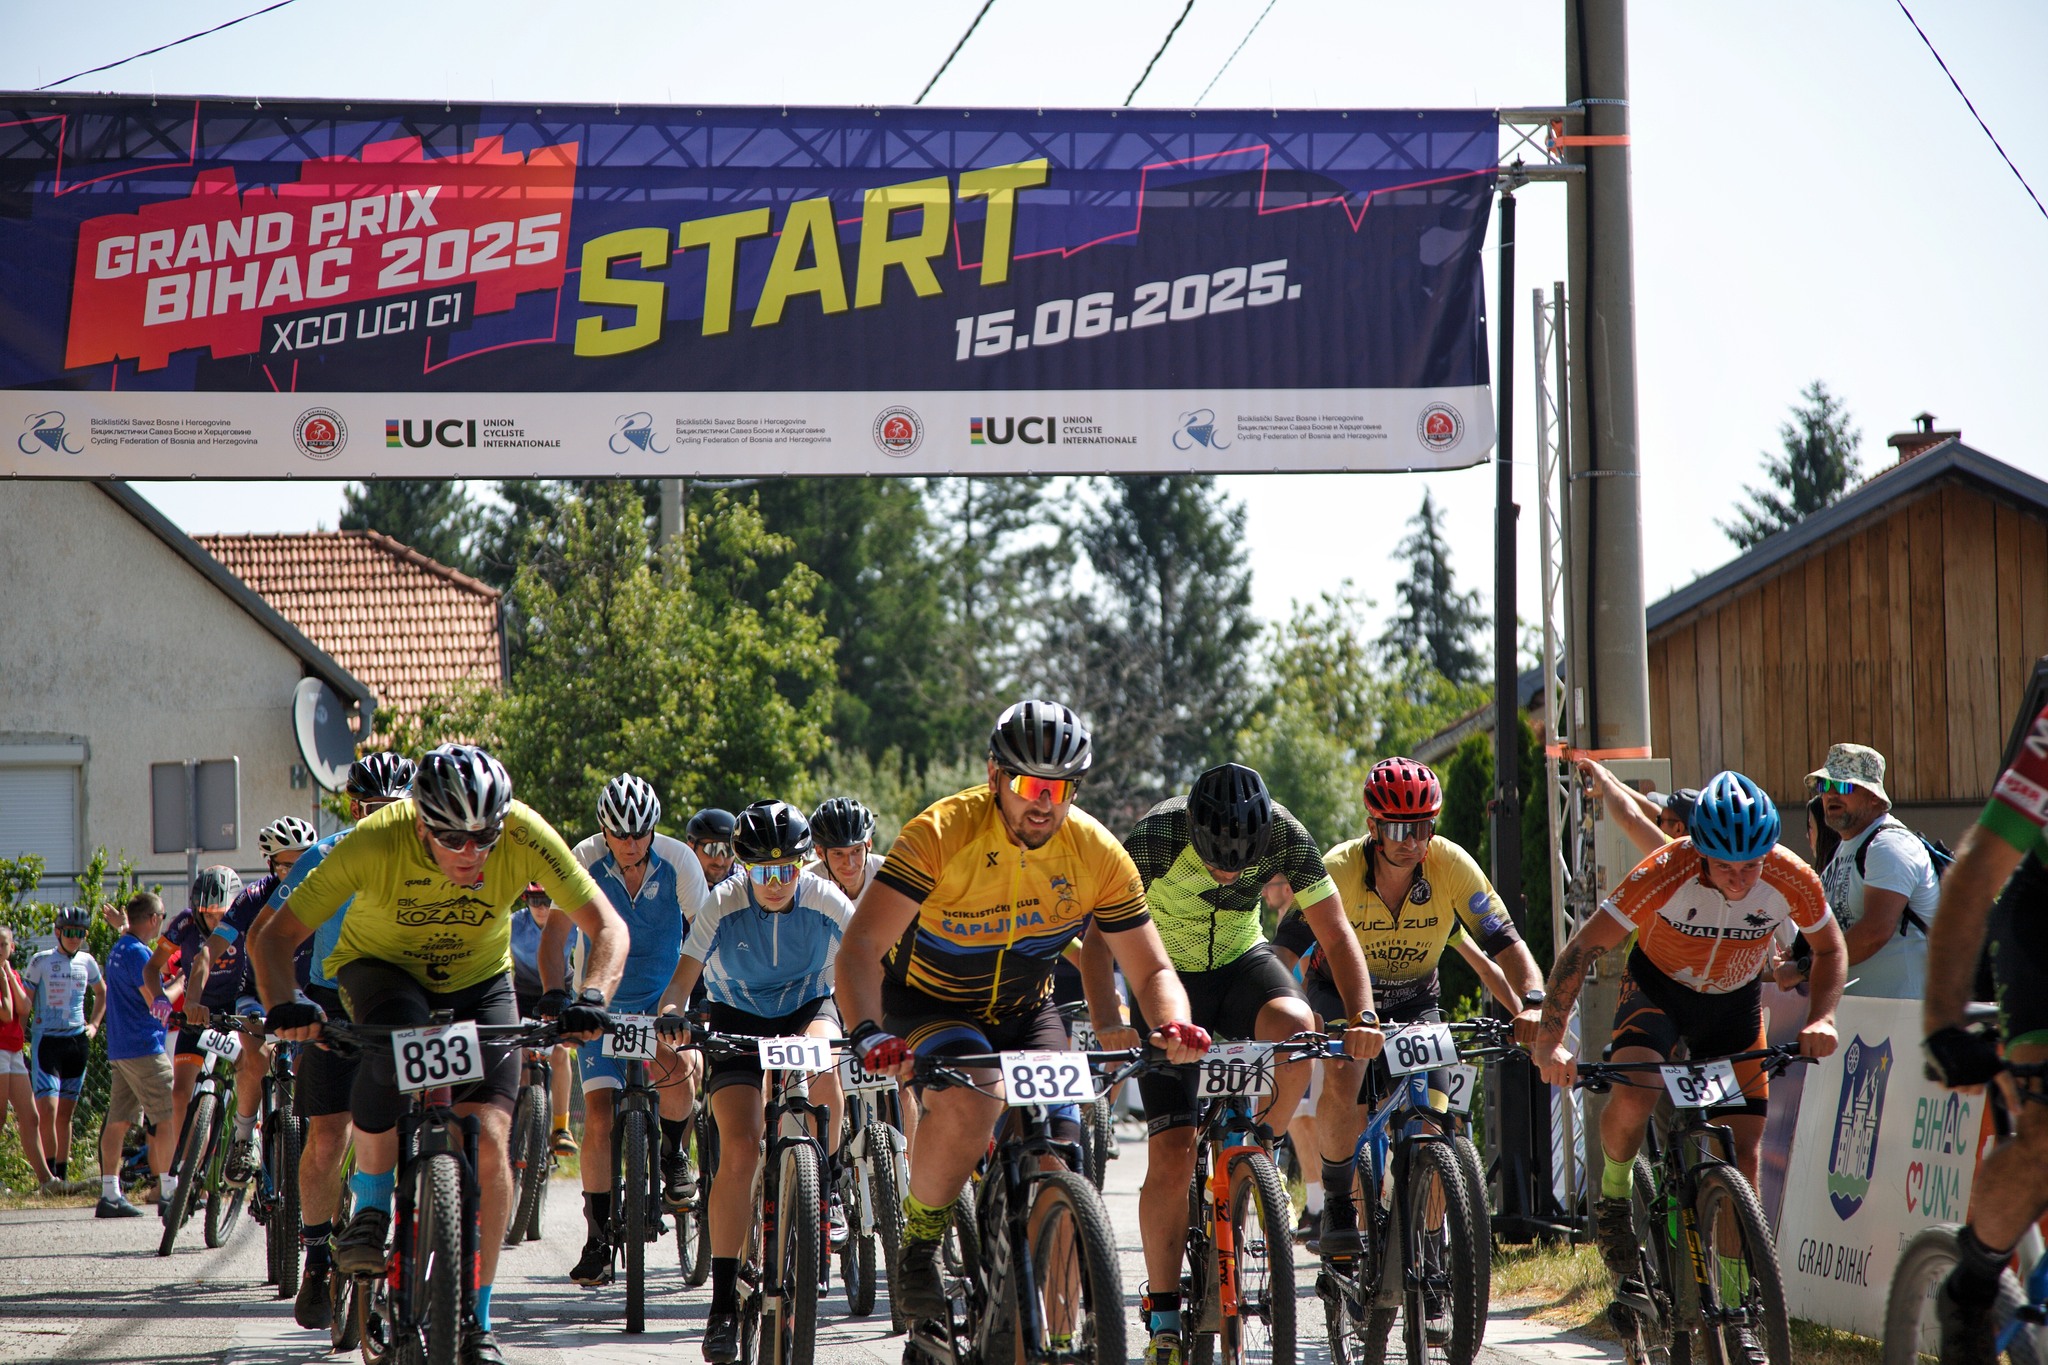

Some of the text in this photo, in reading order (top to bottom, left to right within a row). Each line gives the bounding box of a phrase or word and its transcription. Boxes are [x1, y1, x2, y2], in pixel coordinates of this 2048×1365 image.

[94, 185, 442, 280] GRAND PRIX
[143, 212, 562, 326] BIHAĆ 2025
[574, 157, 1048, 357] START
[955, 258, 1302, 361] 15.06.2025.
[270, 311, 347, 354] XCO
[356, 300, 417, 339] UCI
[91, 418, 130, 426] Biciklistički
[132, 418, 155, 426] Savez
[156, 418, 179, 426] Bosne
[185, 418, 231, 427] Hercegovine
[91, 428, 147, 436] Бициклистички
[204, 428, 251, 436] Херцеговине
[483, 419, 514, 427] UNION
[764, 418, 806, 426] Hercegovine
[987, 416, 1056, 445] UCI
[1063, 416, 1092, 424] UNION
[91, 437, 117, 446] Cycling
[212, 437, 258, 446] Herzegovina
[403, 419, 476, 448] UCI
[483, 440, 561, 448] INTERNATIONALE
[676, 436, 701, 444] Cycling
[789, 436, 832, 444] Herzegovina
[1063, 436, 1137, 444] INTERNATIONALE
[405, 878, 431, 887] quest
[397, 898, 419, 907] BK
[396, 909, 496, 925] KOZARA
[1403, 917, 1438, 929] ZUB
[206, 1031, 236, 1055] 905
[612, 1023, 648, 1054] 891
[1395, 1033, 1443, 1067] 861
[403, 1035, 472, 1083] 833
[767, 1044, 821, 1067] 501
[1012, 1065, 1083, 1099] 832
[1206, 1057, 1263, 1093] 801
[1677, 1074, 1728, 1102] 931
[1922, 1163, 1960, 1222] UNA
[1798, 1238, 1873, 1287] GRAD BIHAĆ
